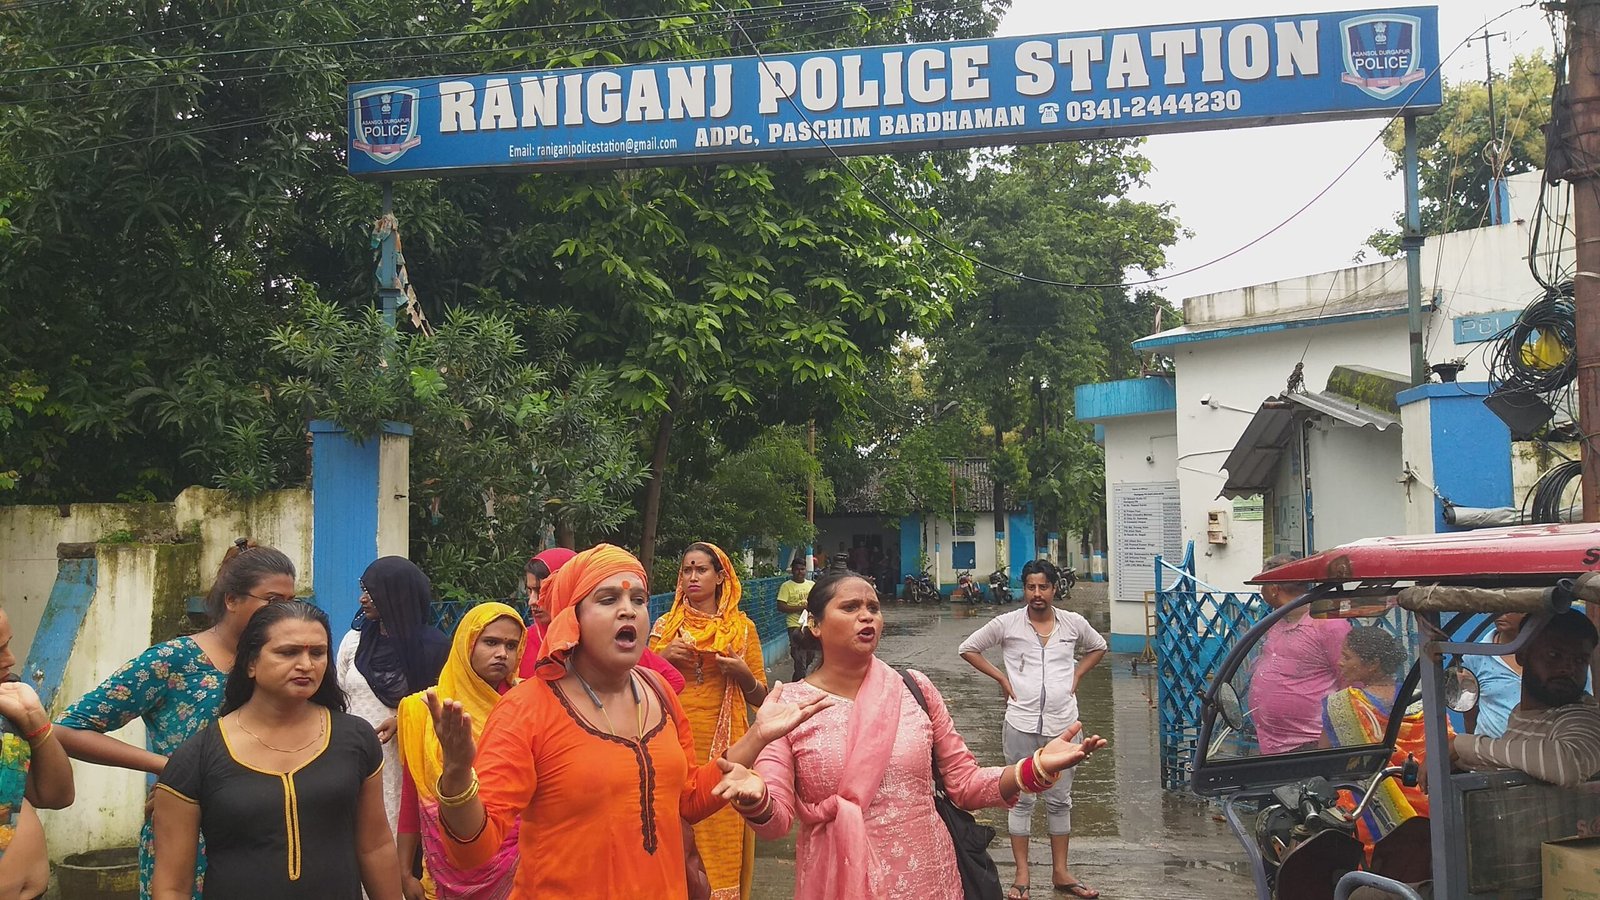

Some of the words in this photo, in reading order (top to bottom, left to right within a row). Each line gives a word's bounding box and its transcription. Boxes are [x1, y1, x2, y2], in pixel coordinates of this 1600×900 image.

[1355, 56, 1408, 70] POLICE
[438, 64, 732, 132] RANIGANJ
[759, 45, 990, 114] POLICE
[1014, 19, 1319, 95] STATION
[695, 124, 759, 147] ADPC,
[768, 118, 869, 143] PASCHIM
[879, 105, 1025, 135] BARDHAMAN
[1066, 89, 1241, 121] 0341-2444230
[364, 124, 408, 137] POLICE
[509, 143, 535, 157] Email:
[537, 136, 677, 158] raniganjpolicestation@gmail.com
